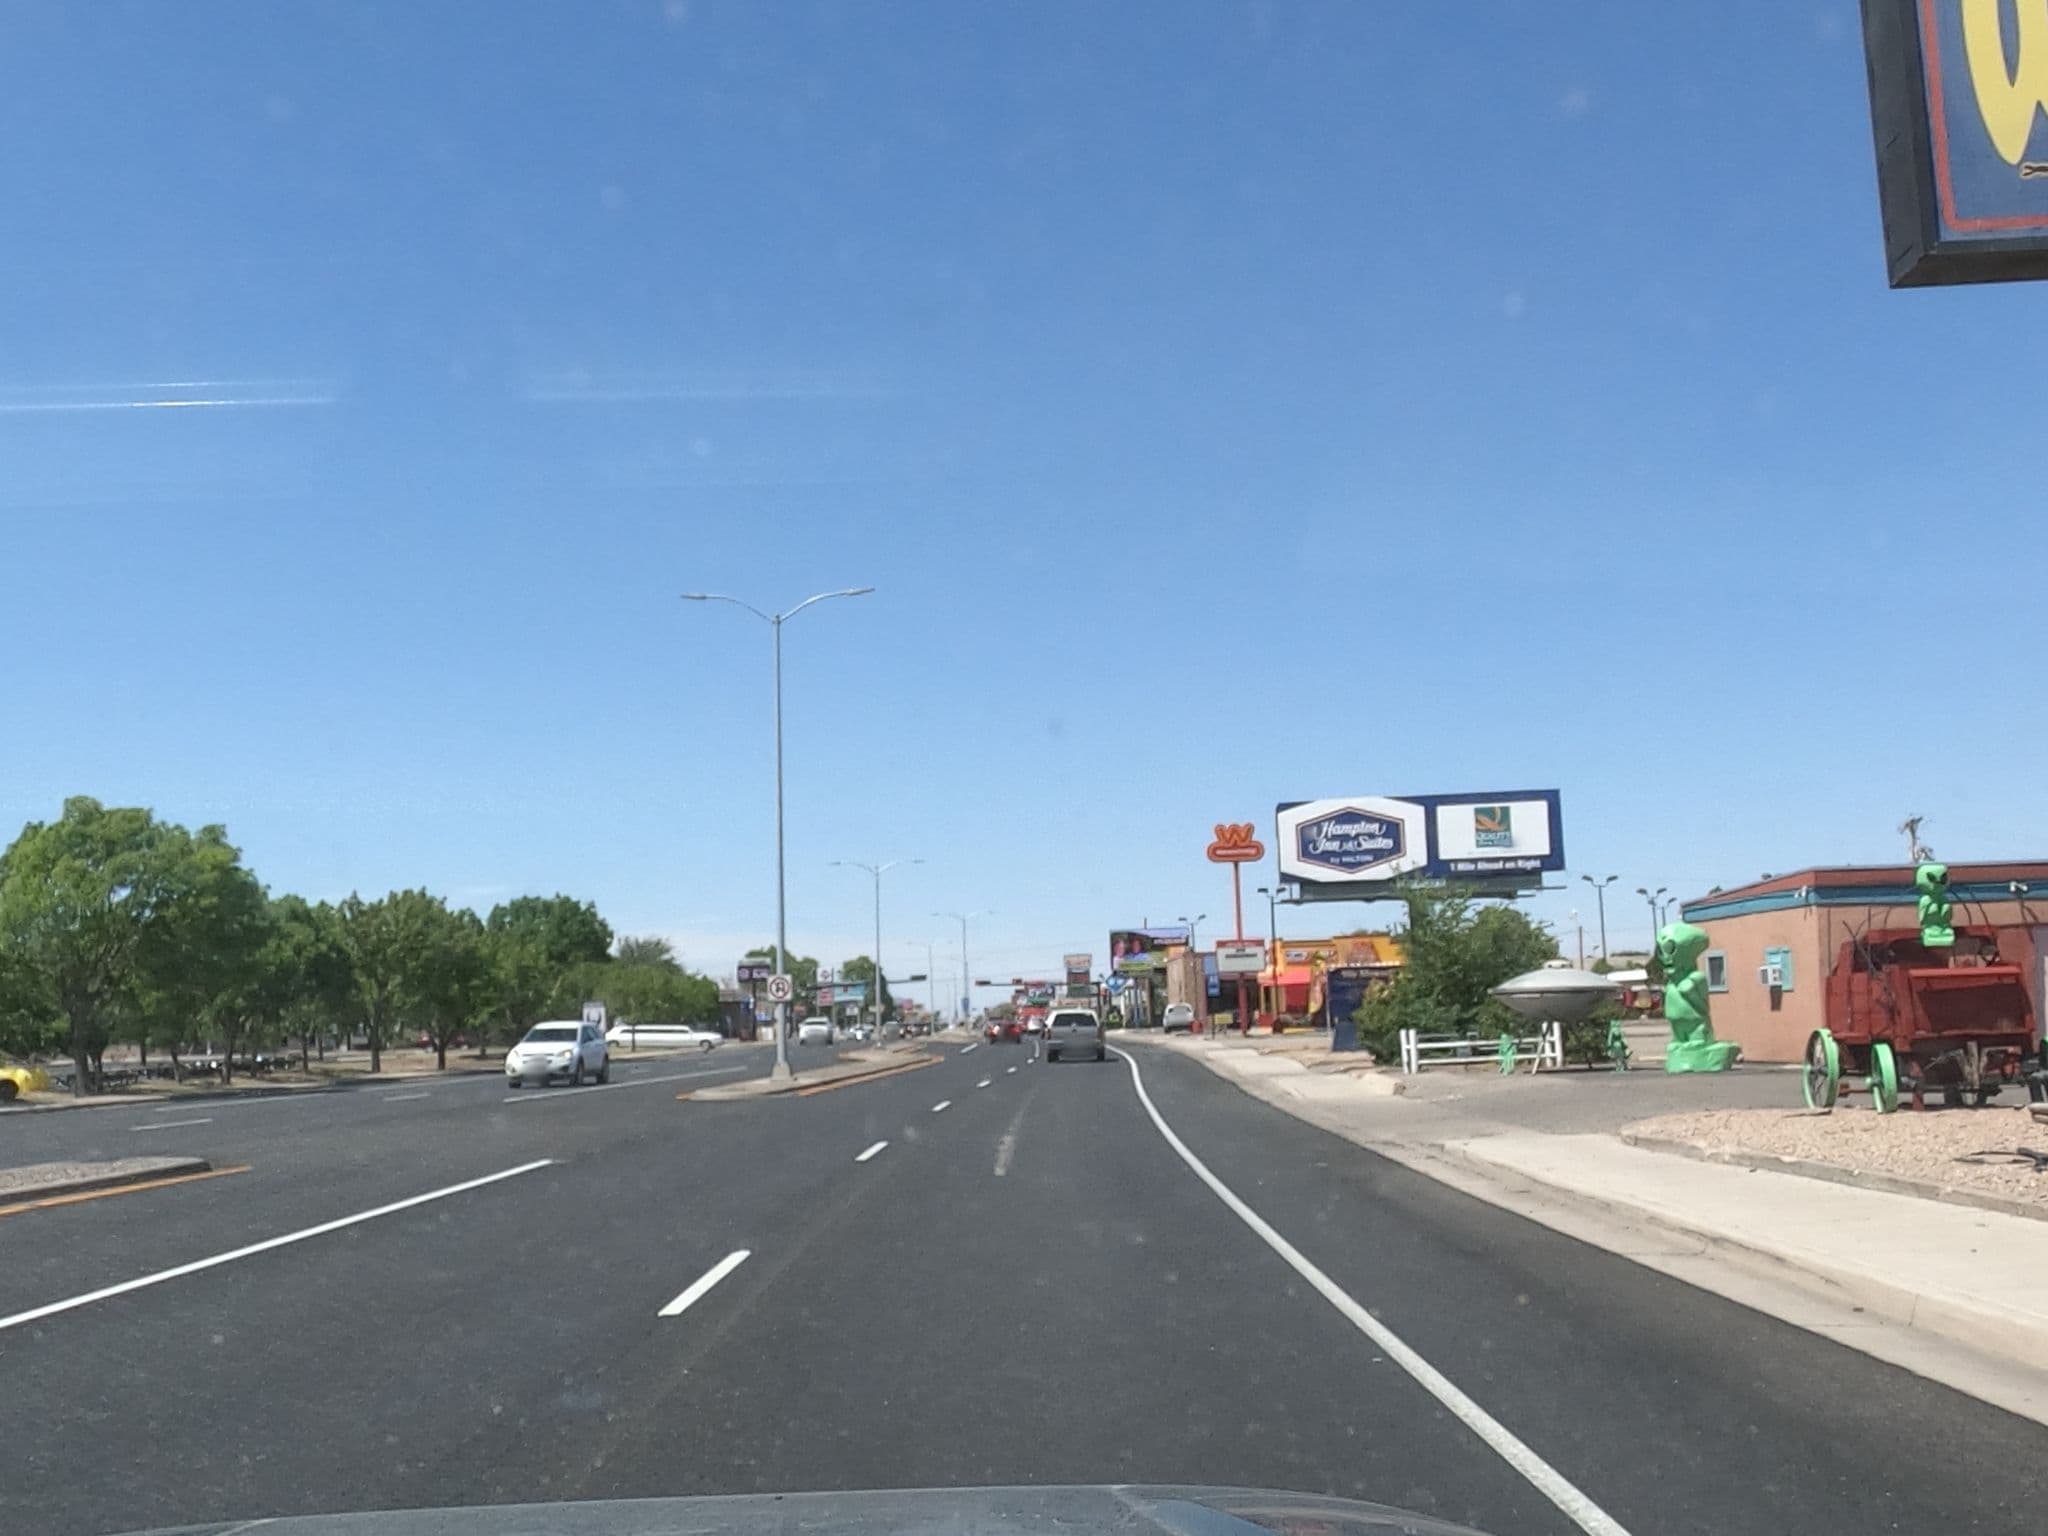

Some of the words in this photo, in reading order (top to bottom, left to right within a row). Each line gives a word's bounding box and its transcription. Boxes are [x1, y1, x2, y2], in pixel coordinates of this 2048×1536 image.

[1313, 819, 1387, 838] Hampton
[1457, 862, 1475, 871] Mile
[1477, 860, 1503, 870] Ahead
[1517, 859, 1541, 871] Right
